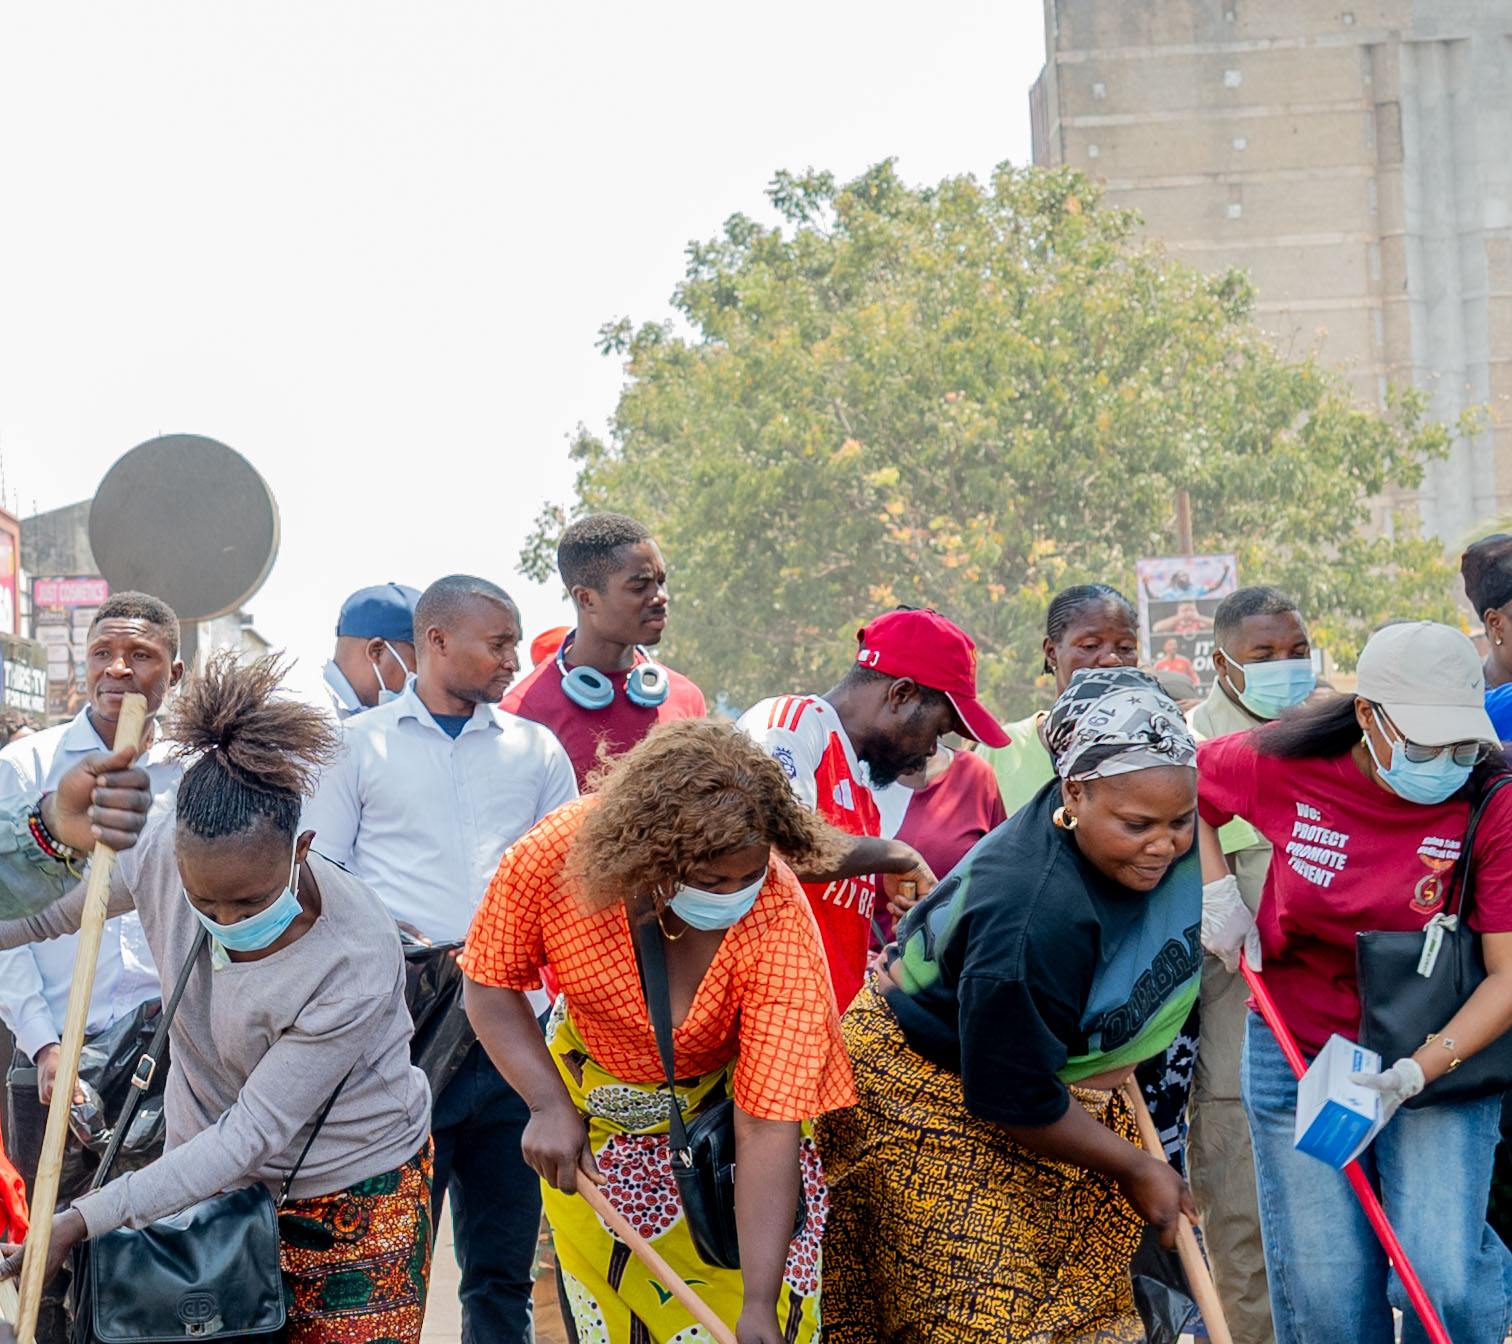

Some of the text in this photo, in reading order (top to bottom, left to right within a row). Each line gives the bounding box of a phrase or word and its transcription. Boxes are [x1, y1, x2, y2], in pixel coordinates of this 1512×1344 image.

[3, 660, 46, 697] THIRSTY
[1296, 801, 1322, 822] We:
[1291, 820, 1350, 849] PROTECT
[1285, 840, 1348, 872] PROMOTE
[1287, 855, 1336, 889] PREVENT
[822, 878, 858, 909] FLY
